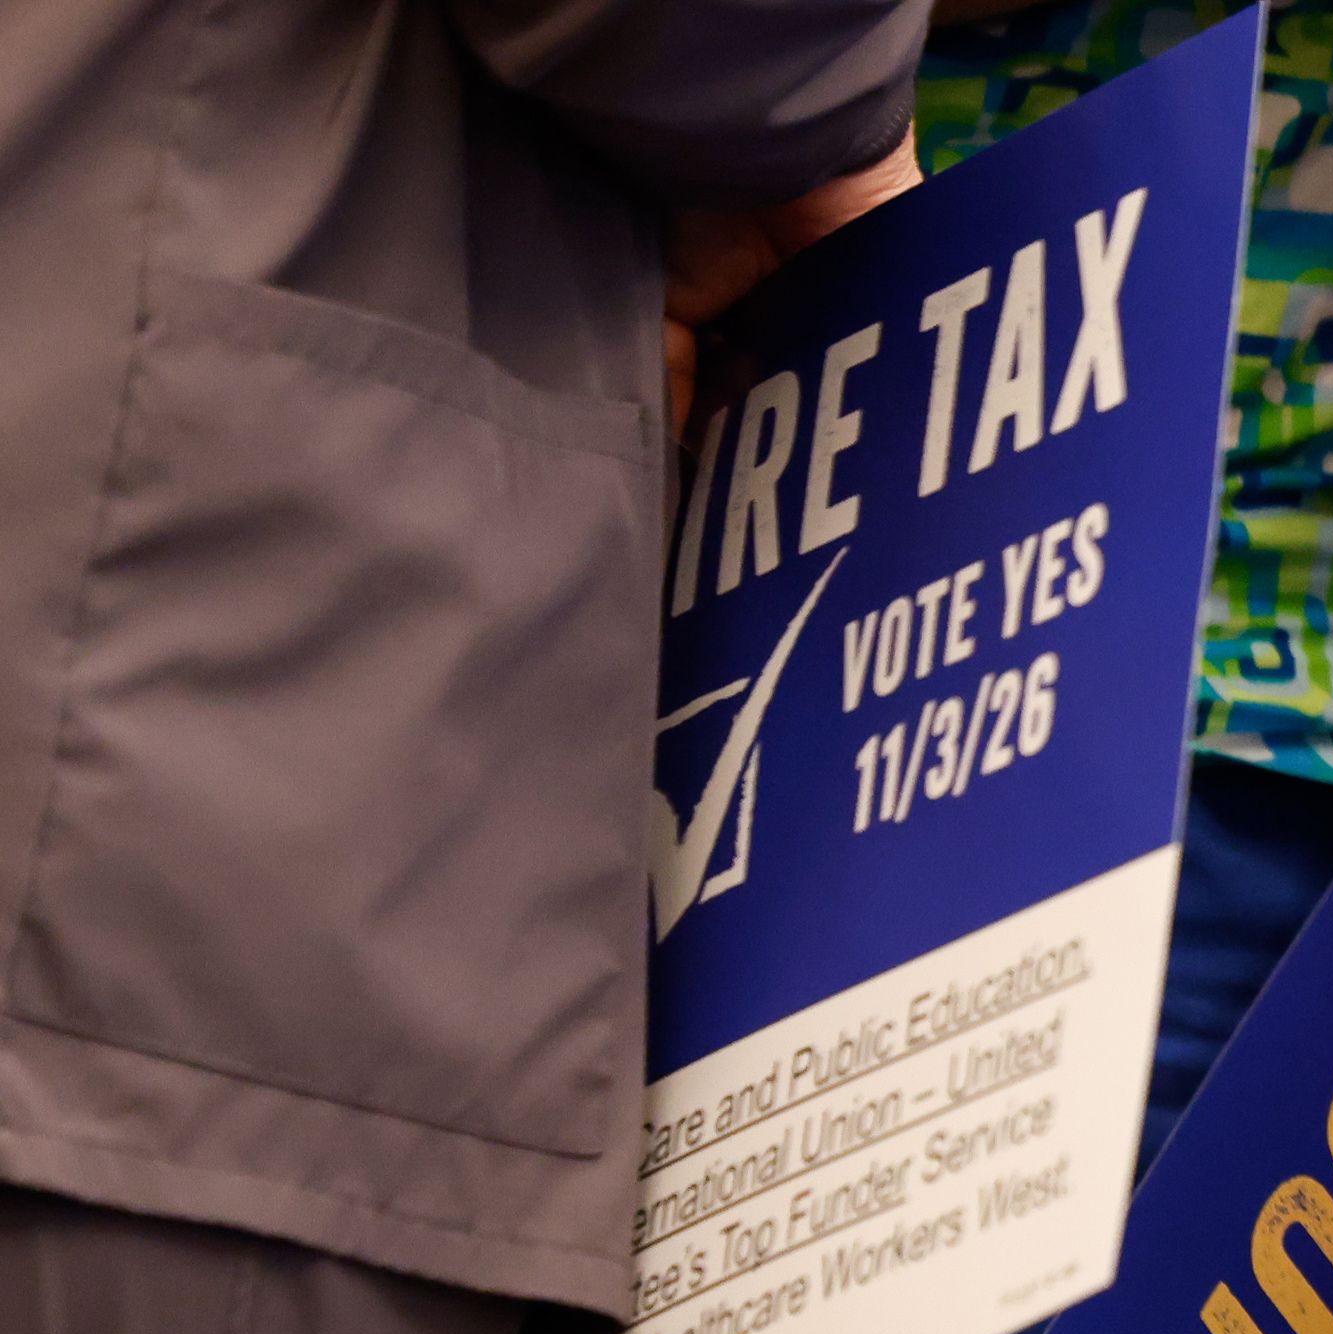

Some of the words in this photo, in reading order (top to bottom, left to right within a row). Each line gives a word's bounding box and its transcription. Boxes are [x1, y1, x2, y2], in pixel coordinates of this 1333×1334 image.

[918, 187, 1148, 498] TAX
[843, 559, 985, 712] VOTE
[1001, 502, 1110, 641] YES
[854, 652, 1060, 833] 11/3/26
[716, 1061, 781, 1134] and
[790, 1015, 896, 1099] Public
[800, 1090, 903, 1163] Union
[948, 1007, 1066, 1102] United
[721, 1220, 775, 1272] Top
[788, 1156, 912, 1246] Funder
[922, 1095, 1056, 1184] Service
[821, 1207, 965, 1299] Workers
